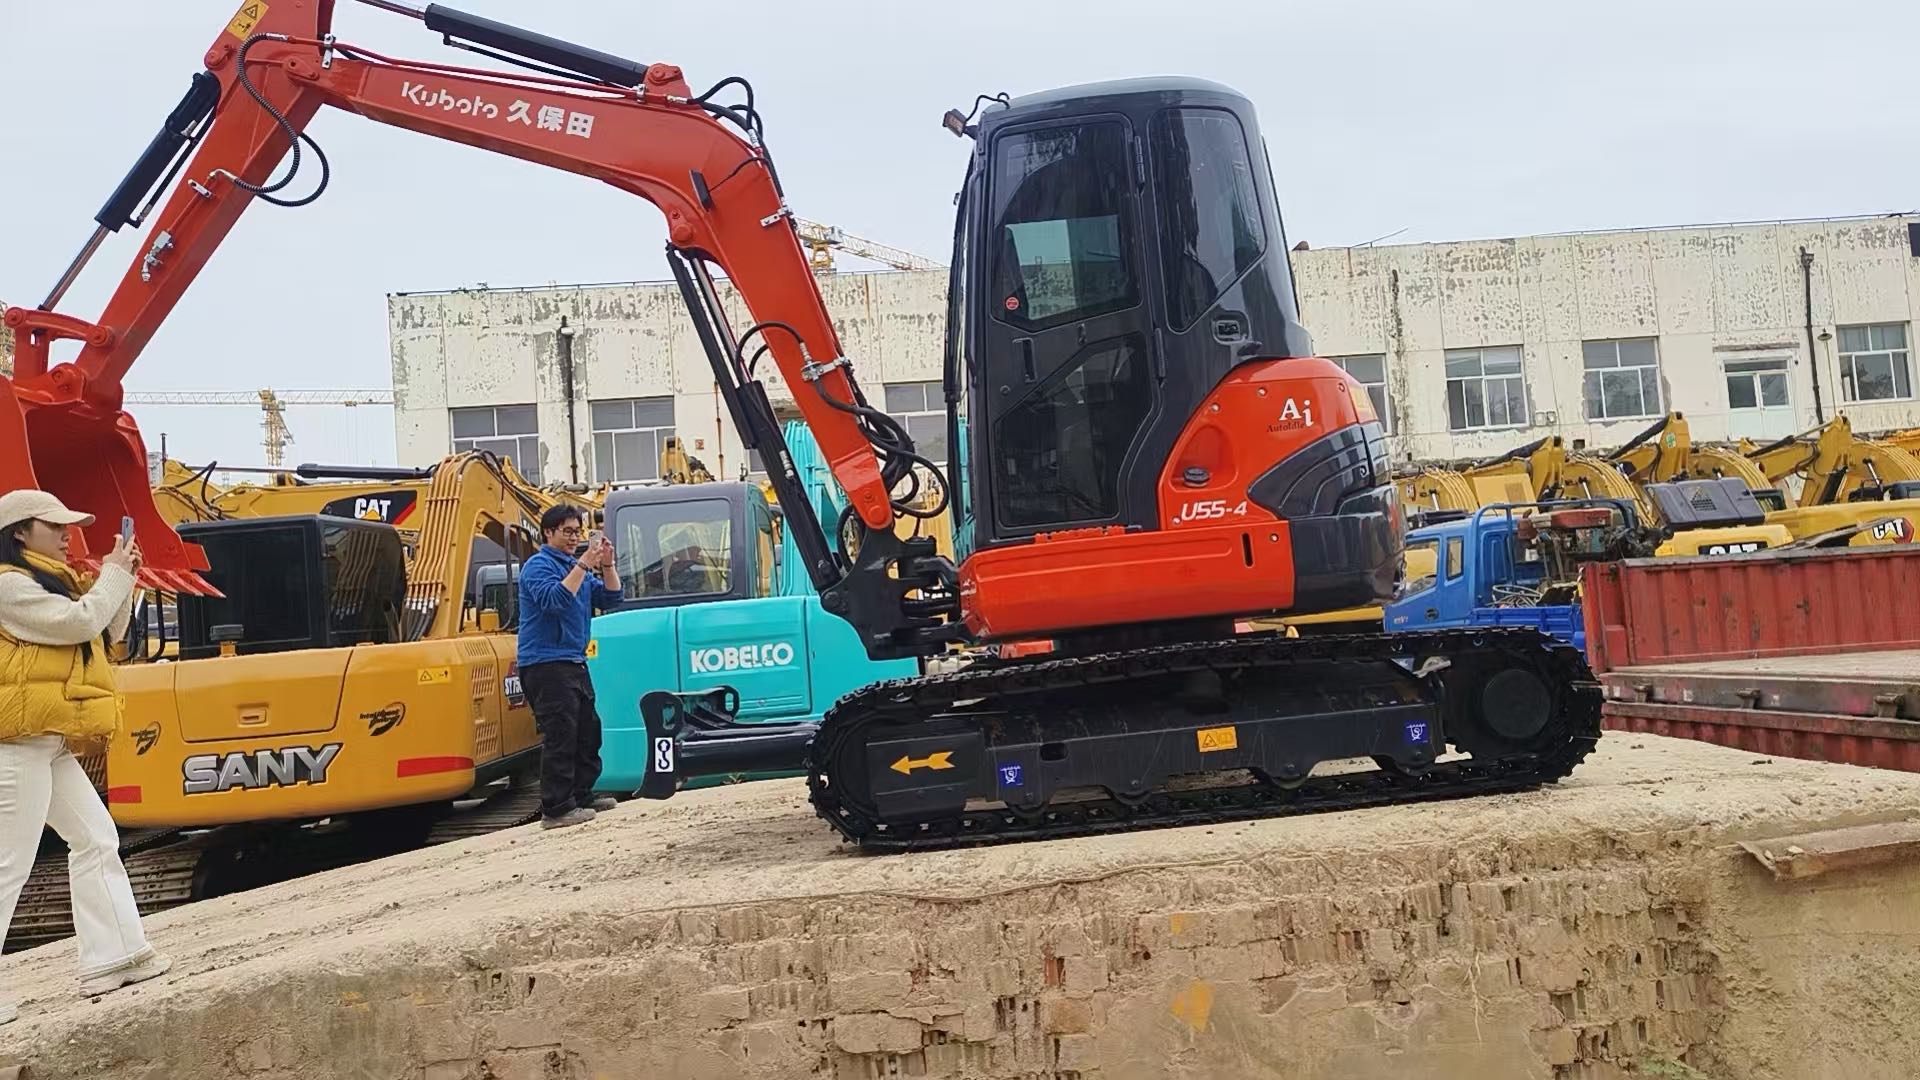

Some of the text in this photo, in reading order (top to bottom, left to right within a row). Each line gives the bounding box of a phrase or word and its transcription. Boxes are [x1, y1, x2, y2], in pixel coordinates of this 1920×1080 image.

[507, 100, 595, 139] 久保田
[1279, 397, 1314, 427] Ai
[354, 497, 391, 522] CAT
[1181, 499, 1248, 521] U55-4
[1872, 517, 1904, 540] CAT
[690, 641, 794, 673] KOBELCO
[182, 742, 344, 796] SANY
